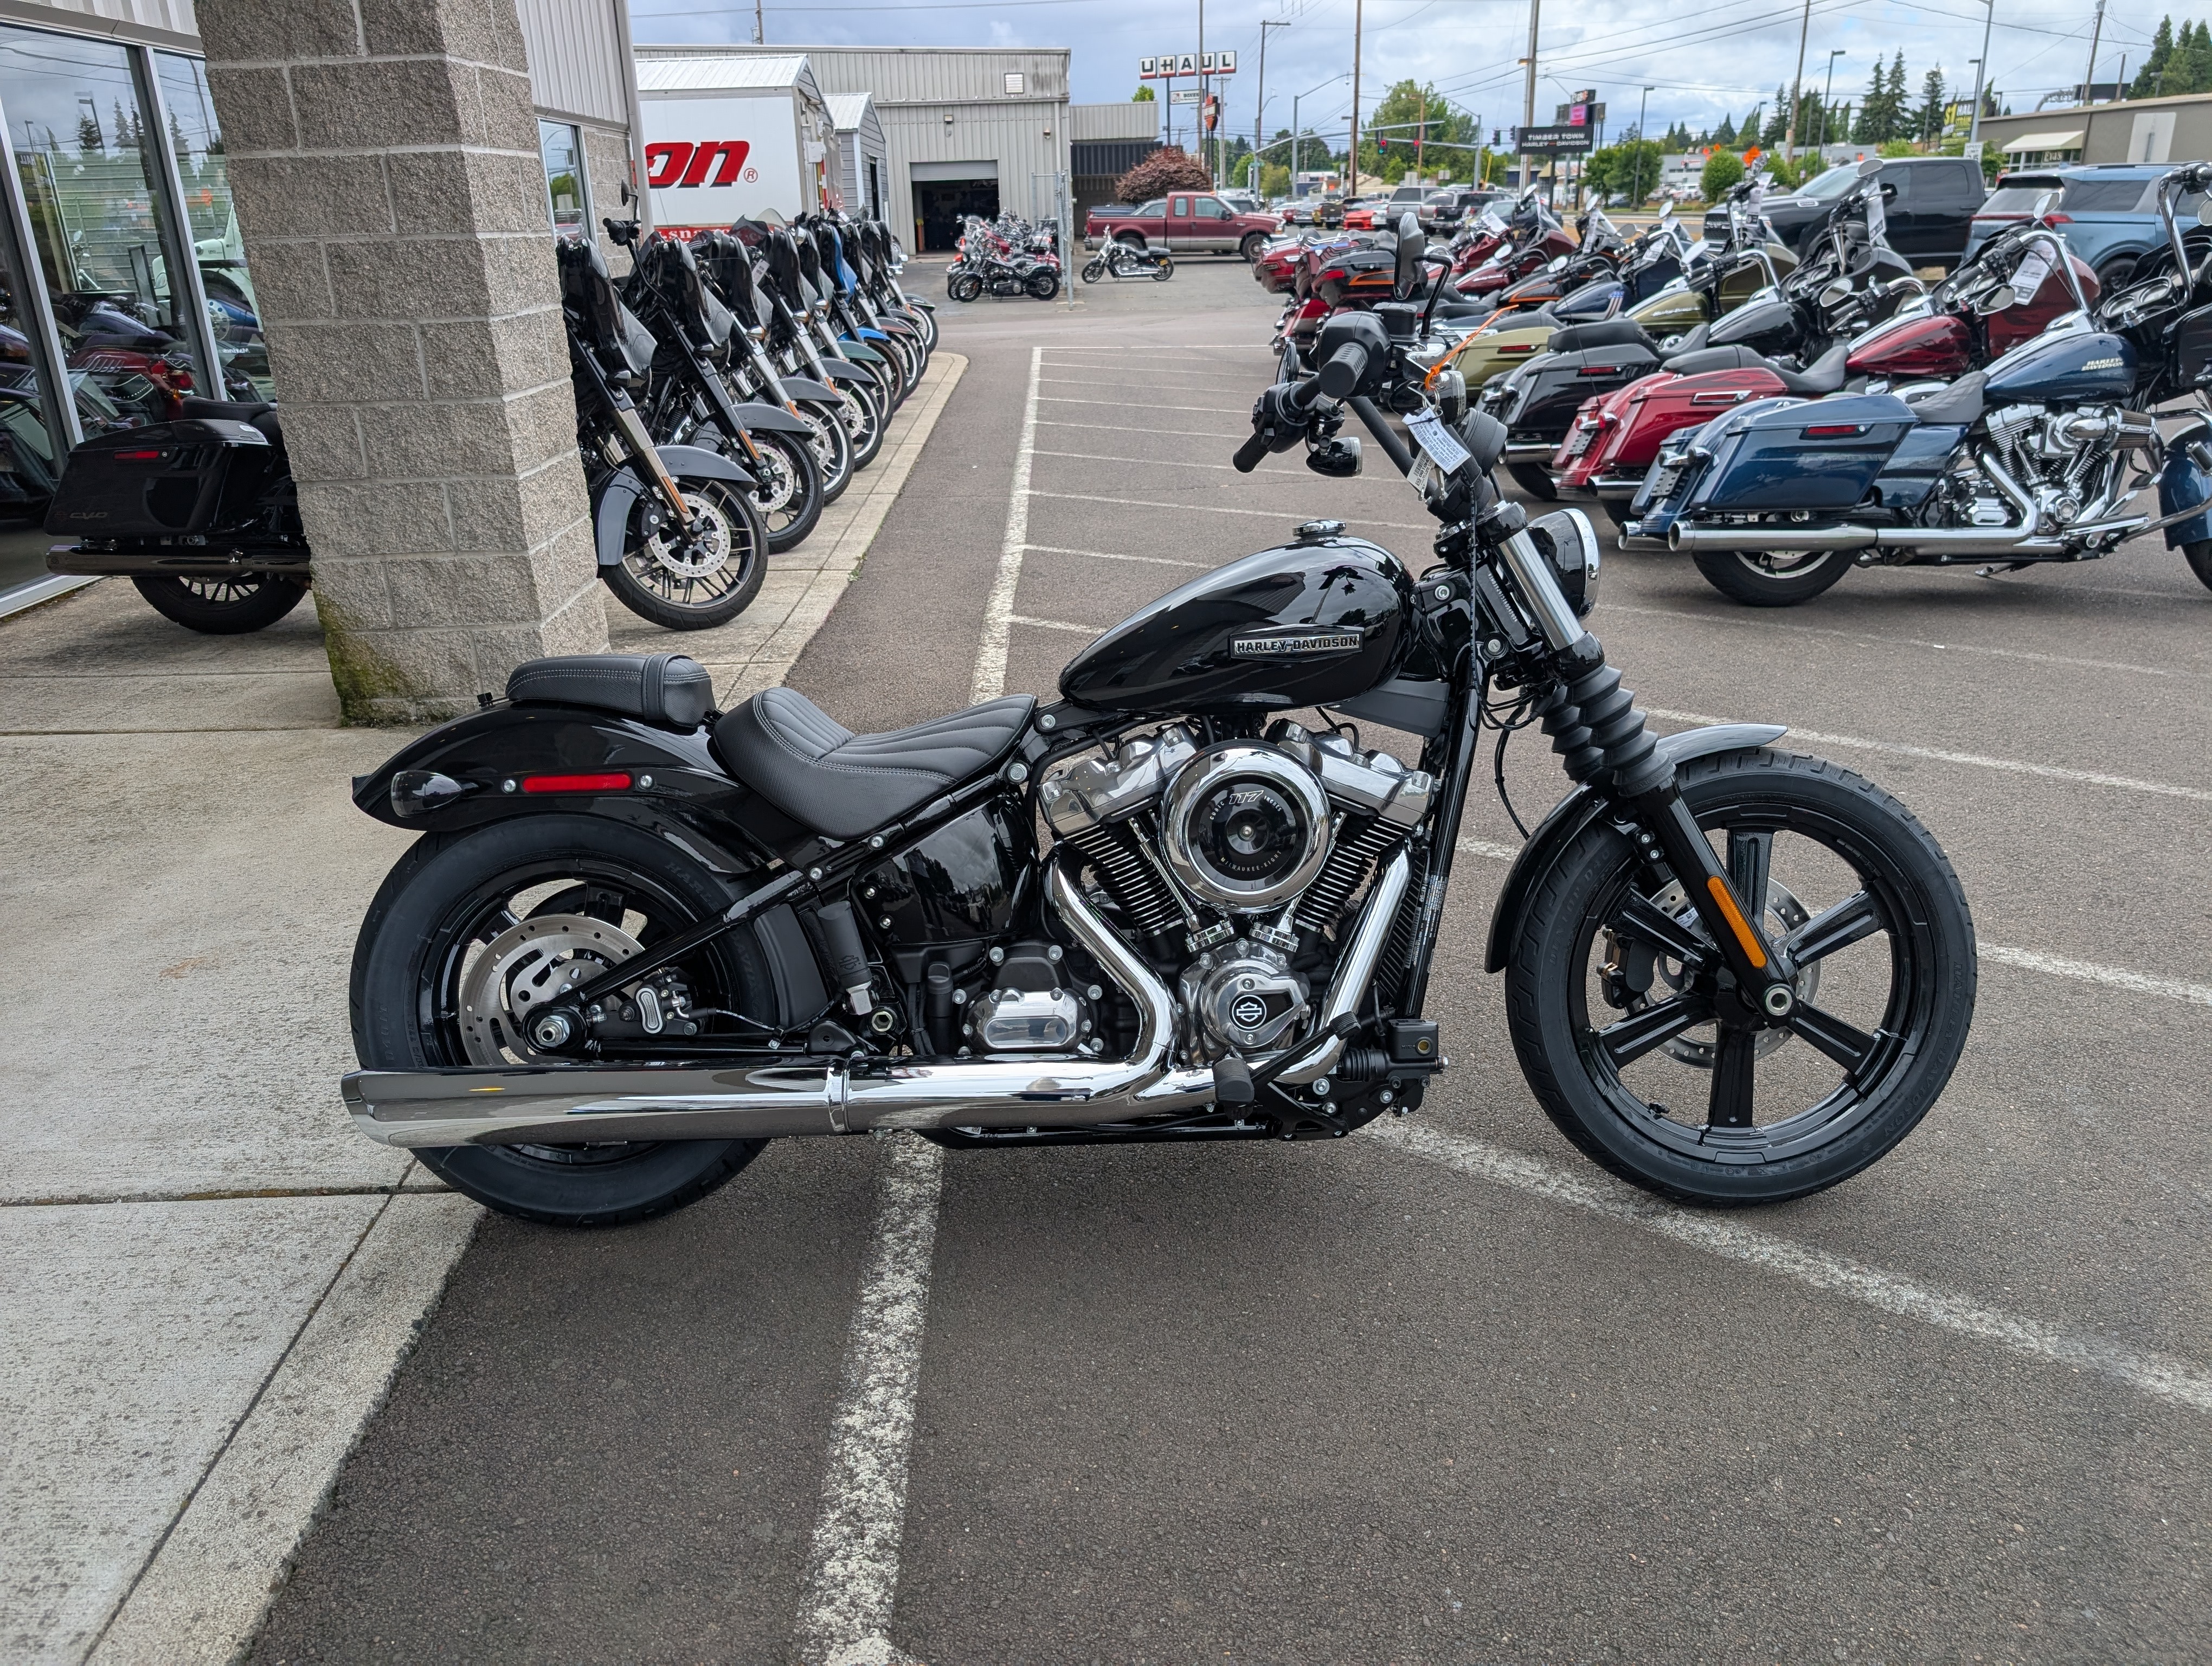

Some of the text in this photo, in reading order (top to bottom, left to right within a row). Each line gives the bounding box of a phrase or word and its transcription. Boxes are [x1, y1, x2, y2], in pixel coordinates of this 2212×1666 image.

[1237, 637, 1359, 653] HARLEY-DAVIDSON
[1210, 790, 1282, 820] CUBIC 117 INCHES
